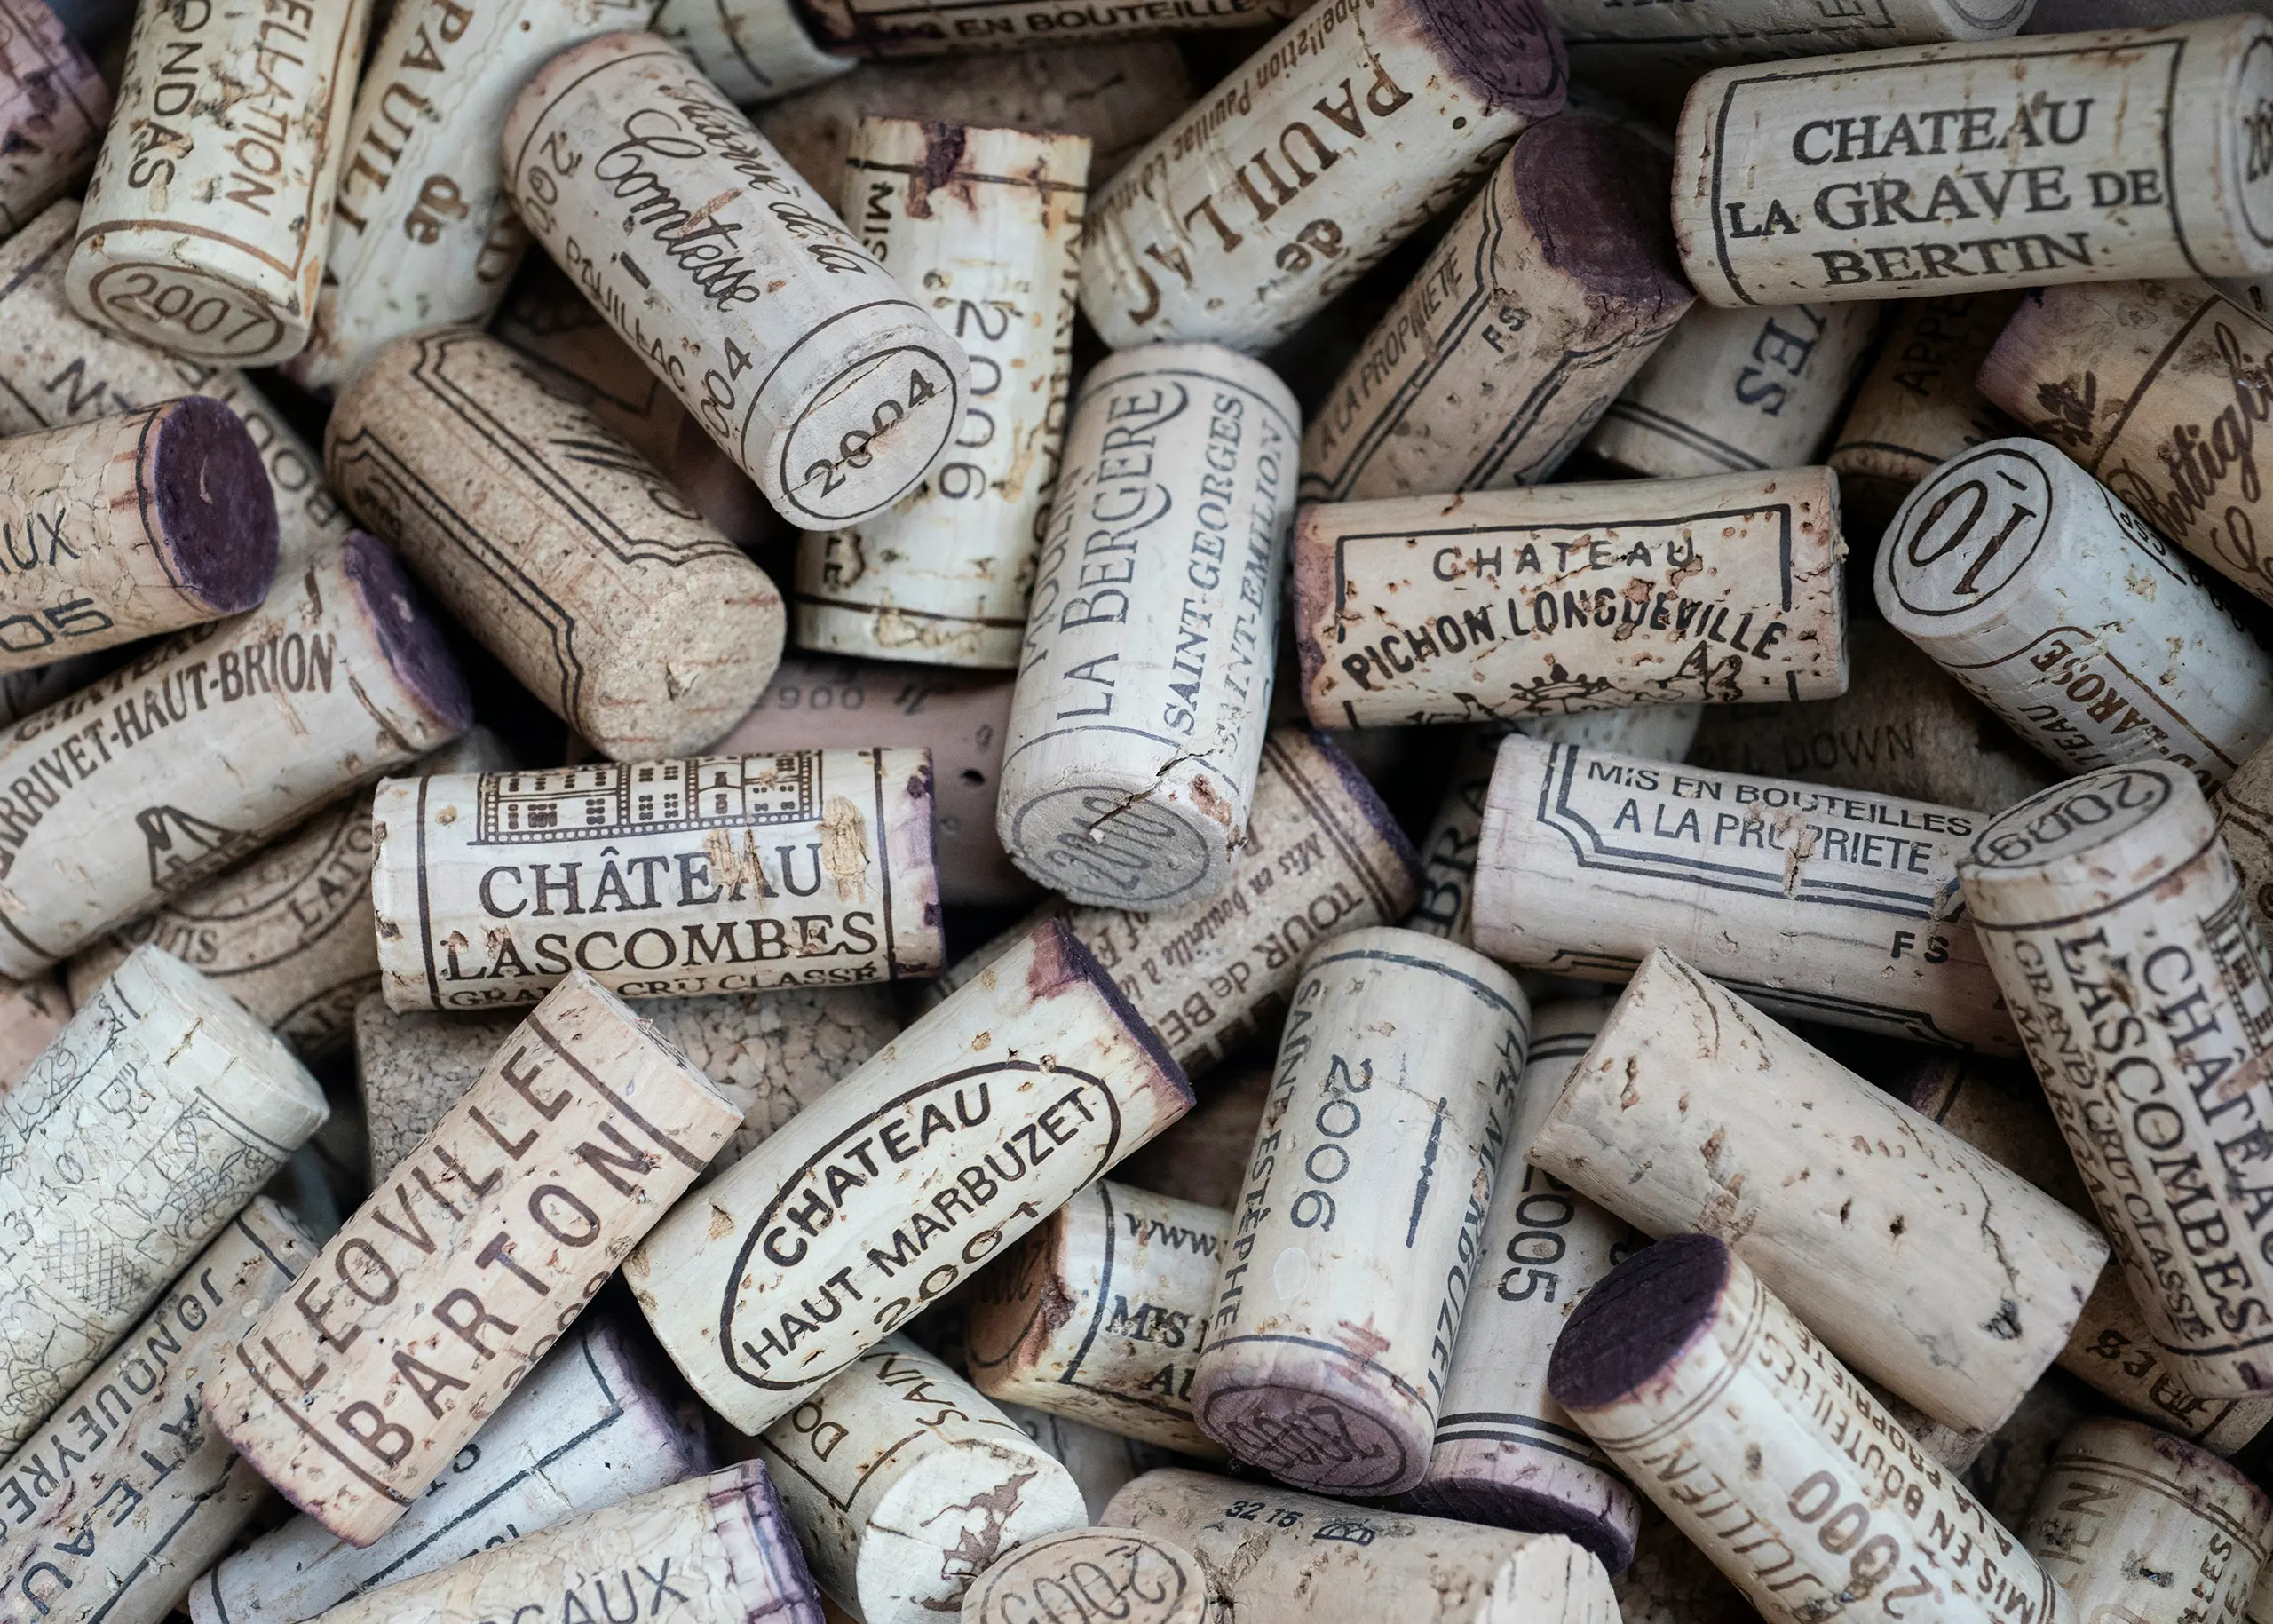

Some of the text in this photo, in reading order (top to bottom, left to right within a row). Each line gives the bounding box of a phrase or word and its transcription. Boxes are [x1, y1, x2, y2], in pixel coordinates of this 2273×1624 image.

[333, 0, 473, 242] PAUILL
[1792, 93, 2096, 167] CHATEAU
[404, 173, 468, 245] de
[595, 109, 762, 313] Comtesse
[1275, 218, 1344, 277] de
[1724, 165, 2166, 239] LA GRAVE DE
[1812, 232, 2096, 286] BERTIN
[107, 271, 266, 346] 2007
[804, 368, 936, 498] 2004
[939, 299, 1010, 501] 2006
[1057, 381, 1190, 722] LA BERGÈRE
[1433, 535, 1698, 582] CHATEAU
[1341, 587, 1787, 692] PICHON LONGUEVILLE
[1588, 761, 1973, 838] MIS EN BOUTEILLES
[1613, 799, 1642, 834] A
[1653, 804, 1701, 844] LA
[479, 843, 822, 920] CHÂTEAU
[1248, 868, 1276, 897] en
[1277, 831, 1327, 878] Mis
[443, 911, 878, 982] LASCOMBES
[616, 976, 707, 1000] CRU
[1156, 883, 1367, 1049] TOUR de BE
[763, 1082, 994, 1270] CHATEAU
[1290, 1054, 1373, 1232] 2006
[2054, 926, 2272, 1335] LASCOMBES
[261, 1045, 574, 1392] LEOVILLE
[742, 1265, 867, 1372] HAUT
[866, 1086, 1099, 1279] MARBUZET
[1497, 1161, 1576, 1303] 2005
[336, 1121, 664, 1470] BARTON
[873, 1199, 1044, 1334] 2001
[1105, 1295, 1195, 1349] MIS
[20, 1376, 206, 1616] ATEAU
[1927, 1508, 1974, 1567] EN
[1786, 1469, 1936, 1620] 2000
[1976, 1558, 2039, 1624] MIS
